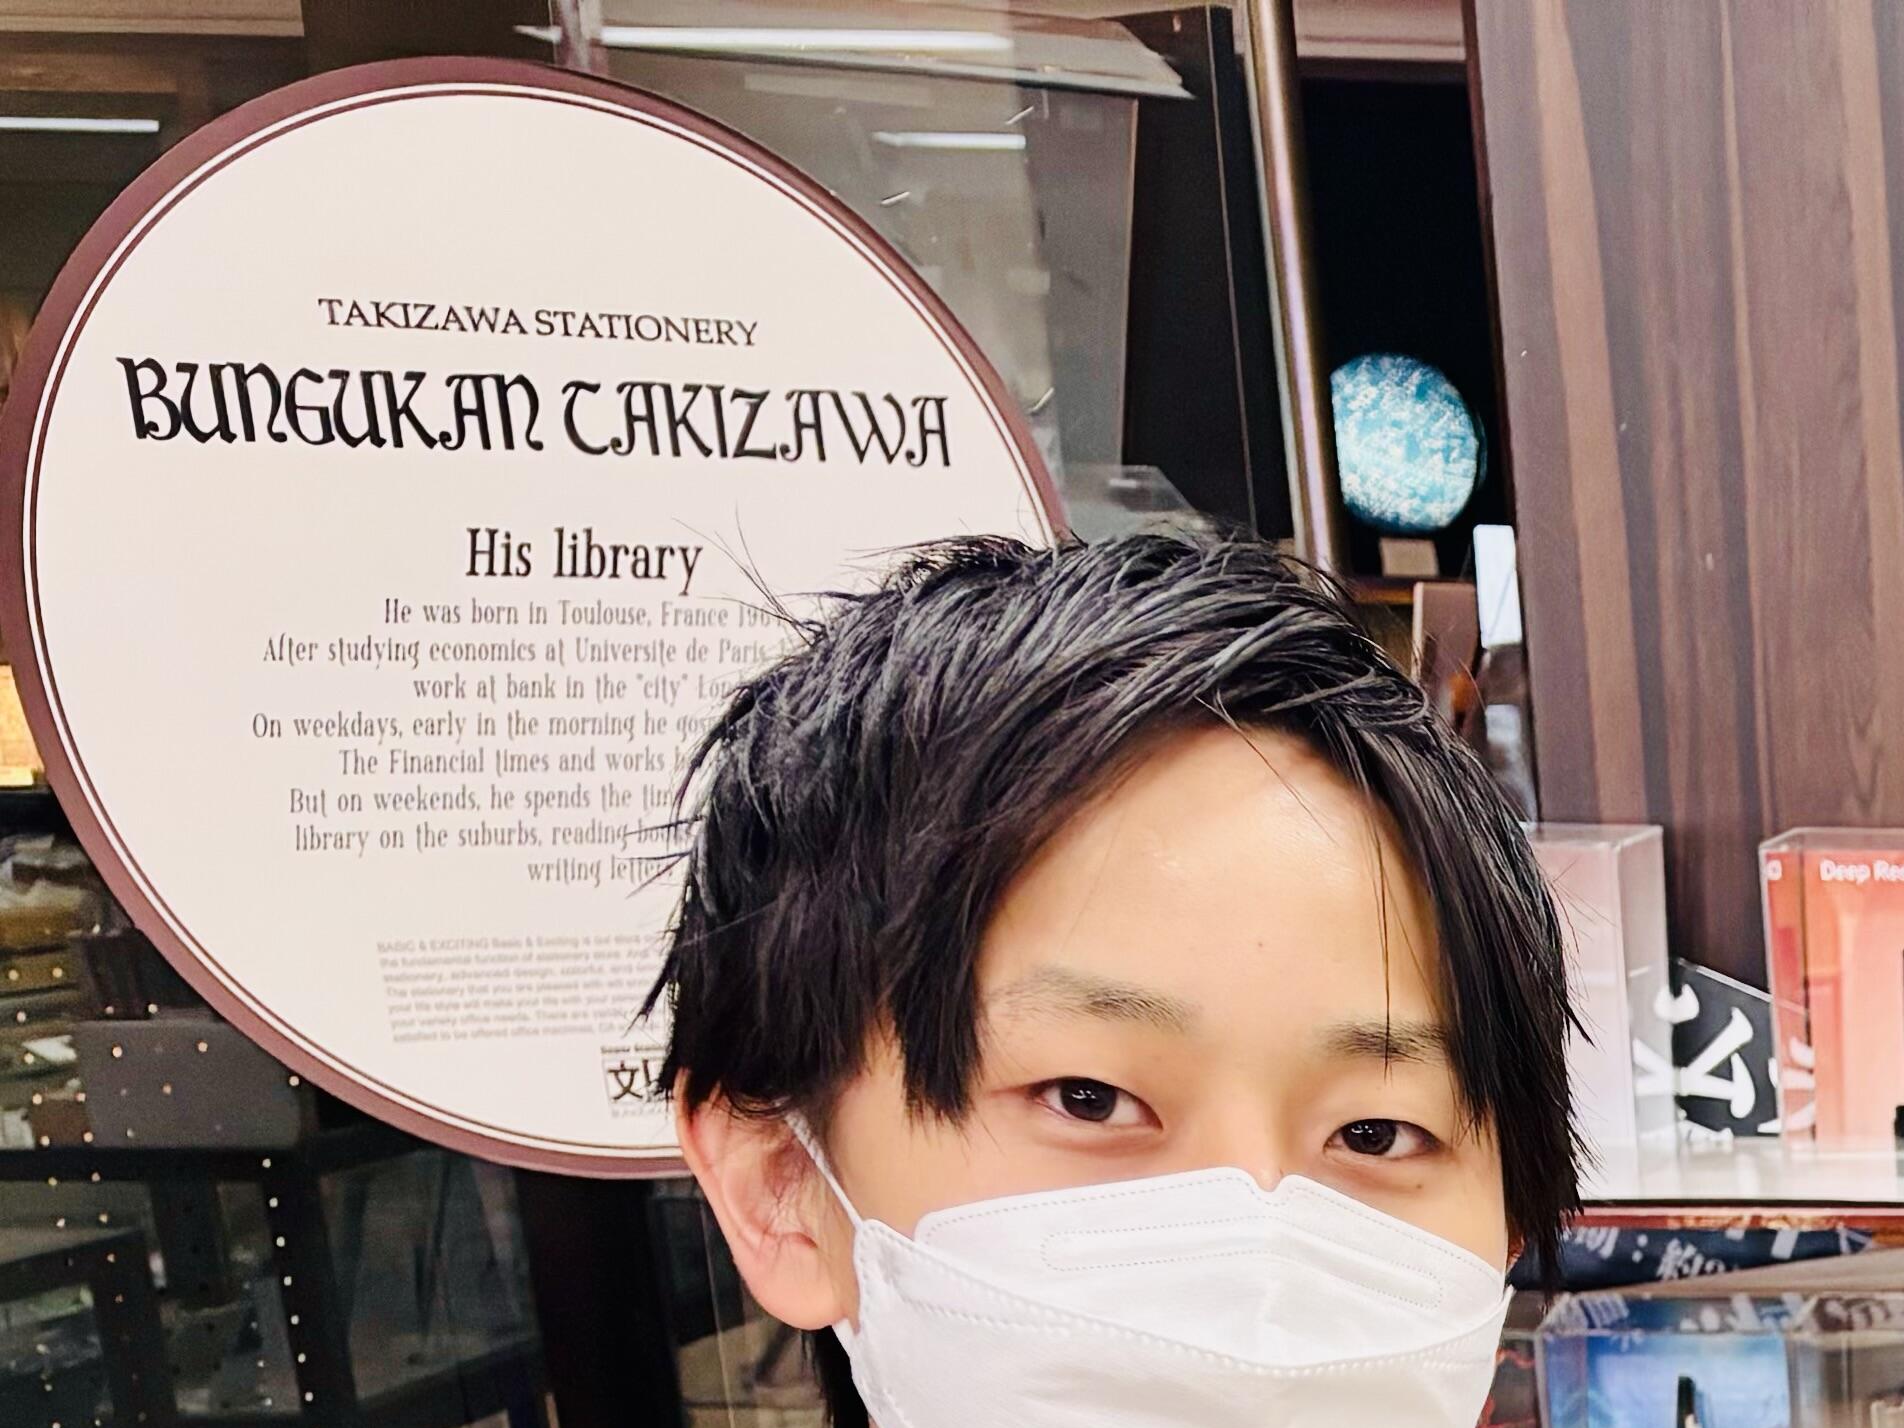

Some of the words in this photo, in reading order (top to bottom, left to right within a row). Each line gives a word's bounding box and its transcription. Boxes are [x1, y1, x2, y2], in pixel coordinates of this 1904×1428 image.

[318, 298, 528, 337] TAKIZAWA
[534, 309, 758, 348] STATIONERY
[115, 355, 545, 453] BUNGUKAN
[561, 379, 952, 468] TAKIZAWA
[466, 527, 532, 578] His
[553, 526, 703, 596] library
[385, 598, 411, 624] He
[423, 602, 461, 624] was
[472, 598, 518, 625] born
[529, 600, 547, 625] in
[559, 599, 652, 627] Toulouse,
[662, 601, 728, 627] France
[263, 633, 318, 666] After
[328, 635, 420, 670] studying
[429, 639, 537, 663] economics
[546, 639, 566, 667] at
[576, 637, 677, 667] Universite
[687, 638, 708, 663] de
[414, 672, 466, 699] work
[477, 673, 496, 704] at
[507, 673, 556, 700] bank
[566, 675, 584, 699] in
[596, 675, 626, 704] the
[252, 713, 281, 739] On
[294, 710, 403, 745] weekdays,
[413, 710, 466, 744] early
[477, 711, 496, 736] in
[507, 710, 538, 741] the
[549, 711, 635, 742] morning
[644, 710, 667, 735] he
[339, 749, 377, 775] The
[390, 747, 484, 775] Financial
[497, 748, 549, 778] times
[559, 748, 595, 772] and
[606, 749, 665, 772] works
[290, 788, 328, 817] But
[338, 793, 362, 813] on
[373, 784, 480, 812] weekends,
[490, 784, 515, 811] he
[524, 782, 591, 817] spends
[601, 782, 632, 811] the
[295, 824, 369, 858] library
[379, 830, 404, 849] on
[416, 822, 448, 853] the
[458, 820, 542, 848] suburbs,
[552, 821, 628, 853] reading
[528, 856, 601, 889] writing
[1819, 858, 1870, 885] Deep
